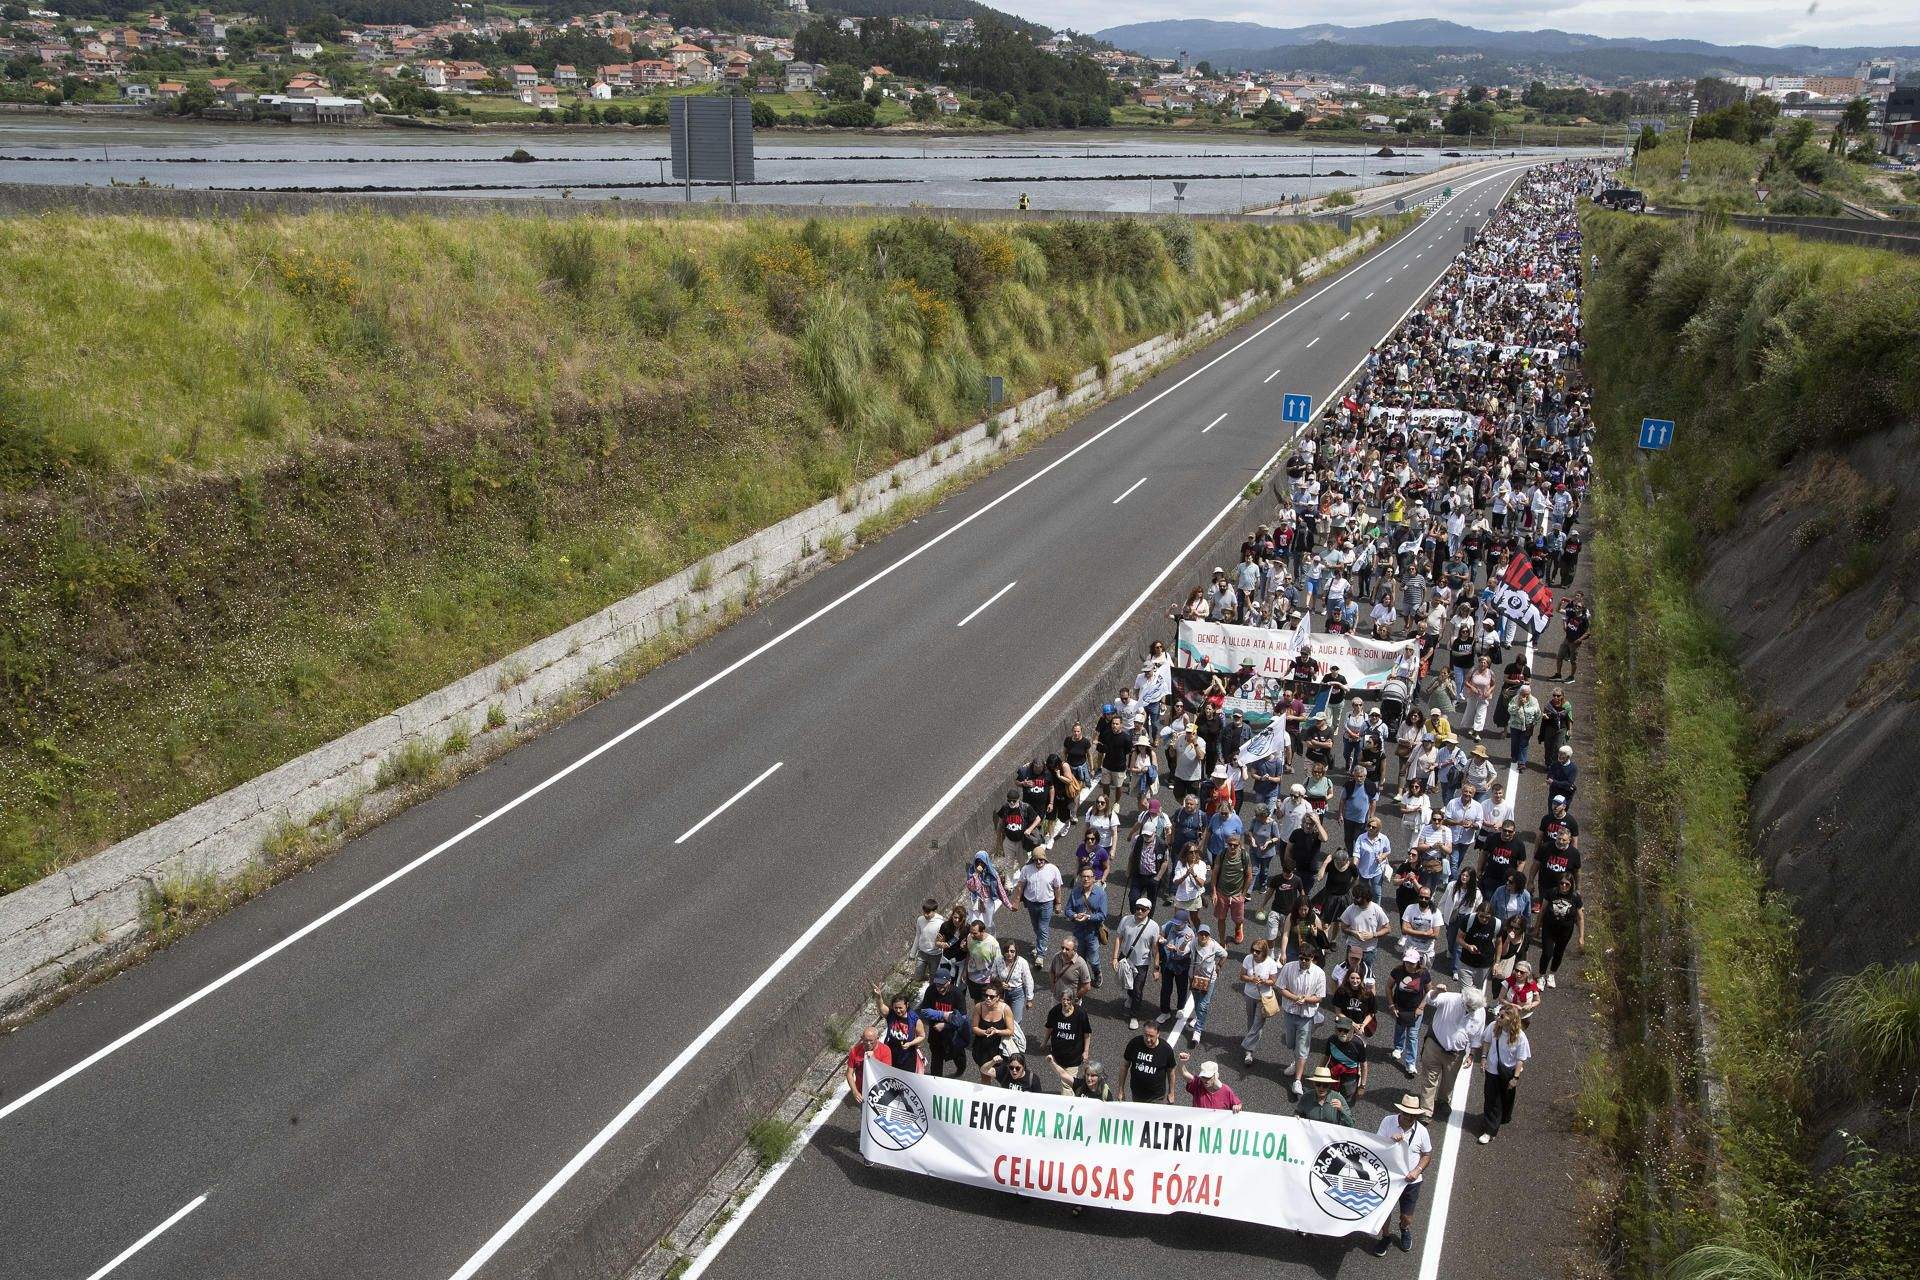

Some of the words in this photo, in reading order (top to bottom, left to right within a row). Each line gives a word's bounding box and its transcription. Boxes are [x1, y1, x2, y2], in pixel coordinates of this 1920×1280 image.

[1198, 634, 1219, 644] DENDE
[1222, 636, 1227, 645] A
[1228, 637, 1250, 647] ULLOA
[1254, 640, 1265, 649] ATA
[1269, 640, 1274, 649] A
[1318, 645, 1338, 655] AUGA
[1340, 646, 1343, 655] E
[1347, 647, 1360, 656] AIRE
[1364, 649, 1378, 659] SON
[1492, 855, 1509, 864] NON
[1546, 863, 1566, 872] NON
[1137, 1051, 1153, 1062] ENCE
[932, 1094, 964, 1126] NIN
[969, 1100, 1017, 1133] ENCE
[1022, 1108, 1046, 1138] NA
[1053, 1105, 1092, 1146] RÍA,
[1098, 1117, 1135, 1146] NIN
[1139, 1121, 1192, 1152] ALTRI
[1198, 1127, 1222, 1154] NA
[1229, 1129, 1305, 1165] ULLOA...
[993, 1155, 1135, 1201] CELULOSAS
[1152, 1164, 1223, 1206] FÓRA!
